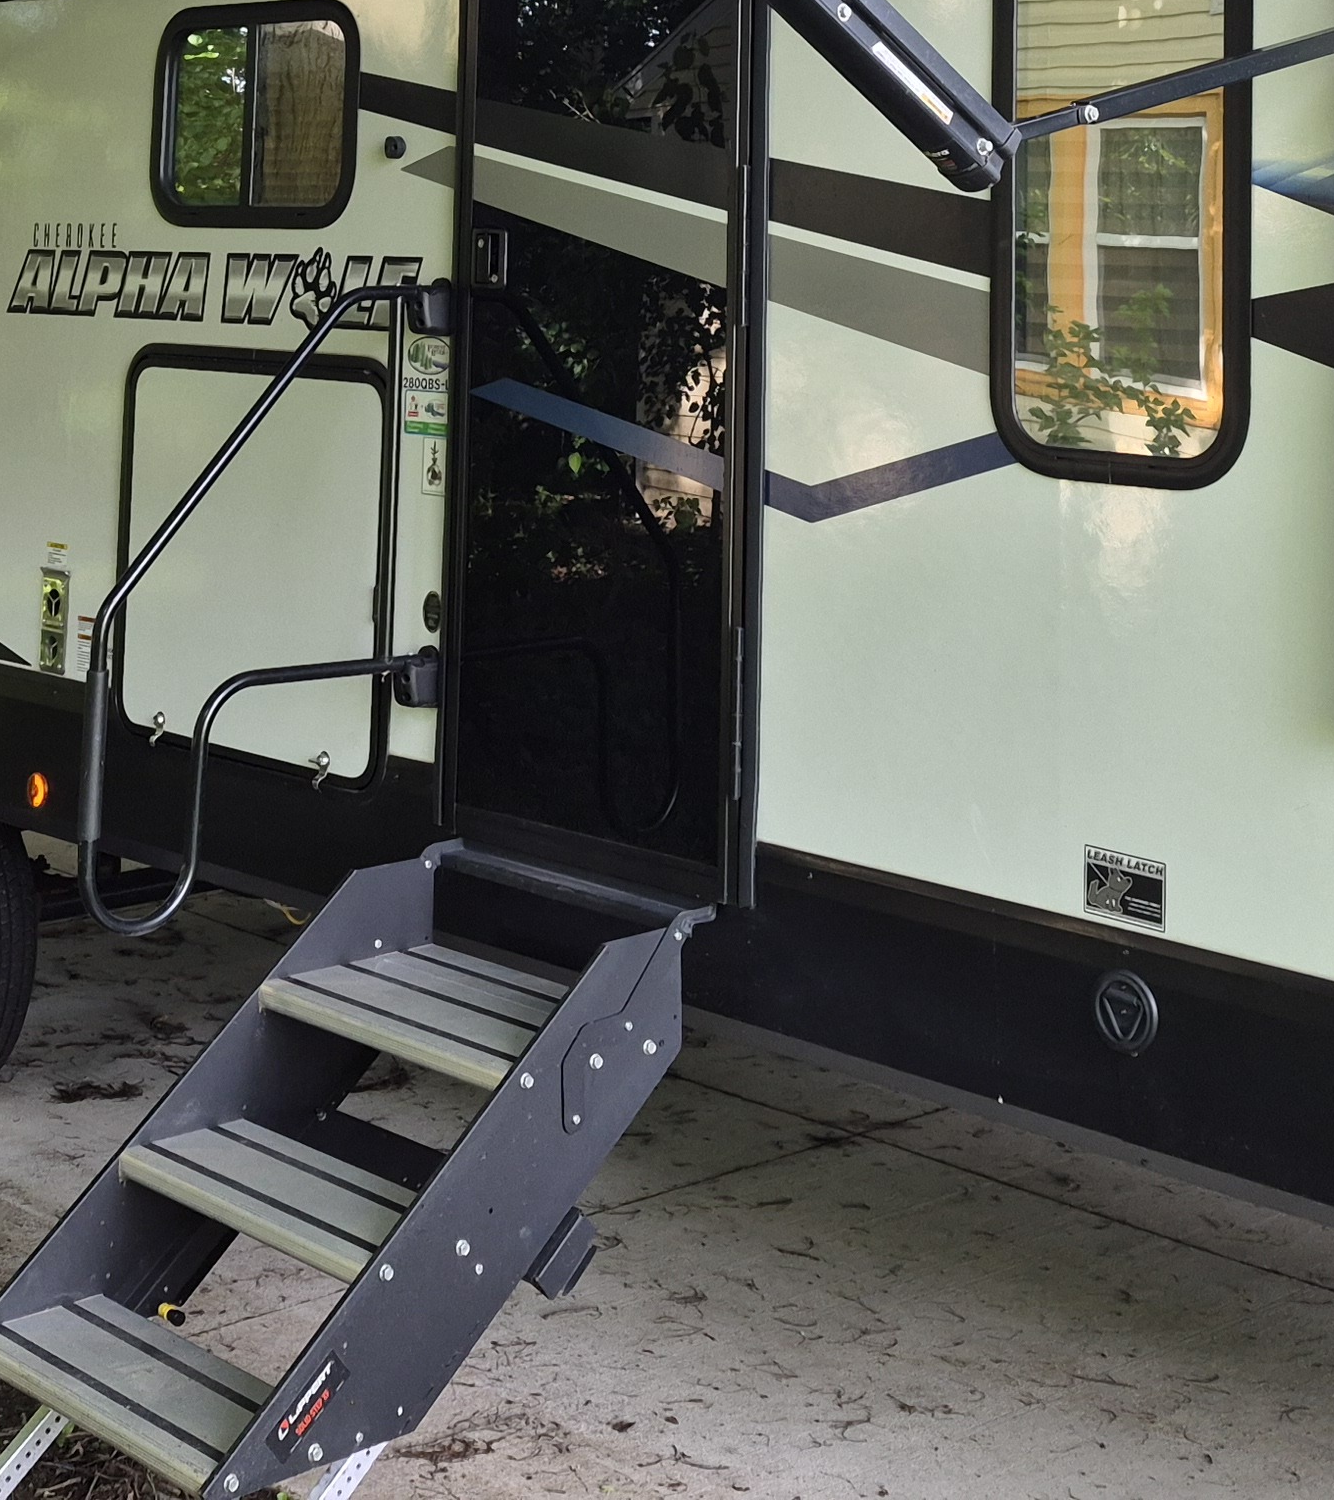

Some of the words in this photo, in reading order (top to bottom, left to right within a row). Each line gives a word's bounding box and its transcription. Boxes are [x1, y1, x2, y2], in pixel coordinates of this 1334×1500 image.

[32, 222, 119, 249] CHEROKEE
[6, 248, 211, 323] ALPHA
[1087, 848, 1124, 868] LEASH
[1125, 857, 1164, 877] LATCH
